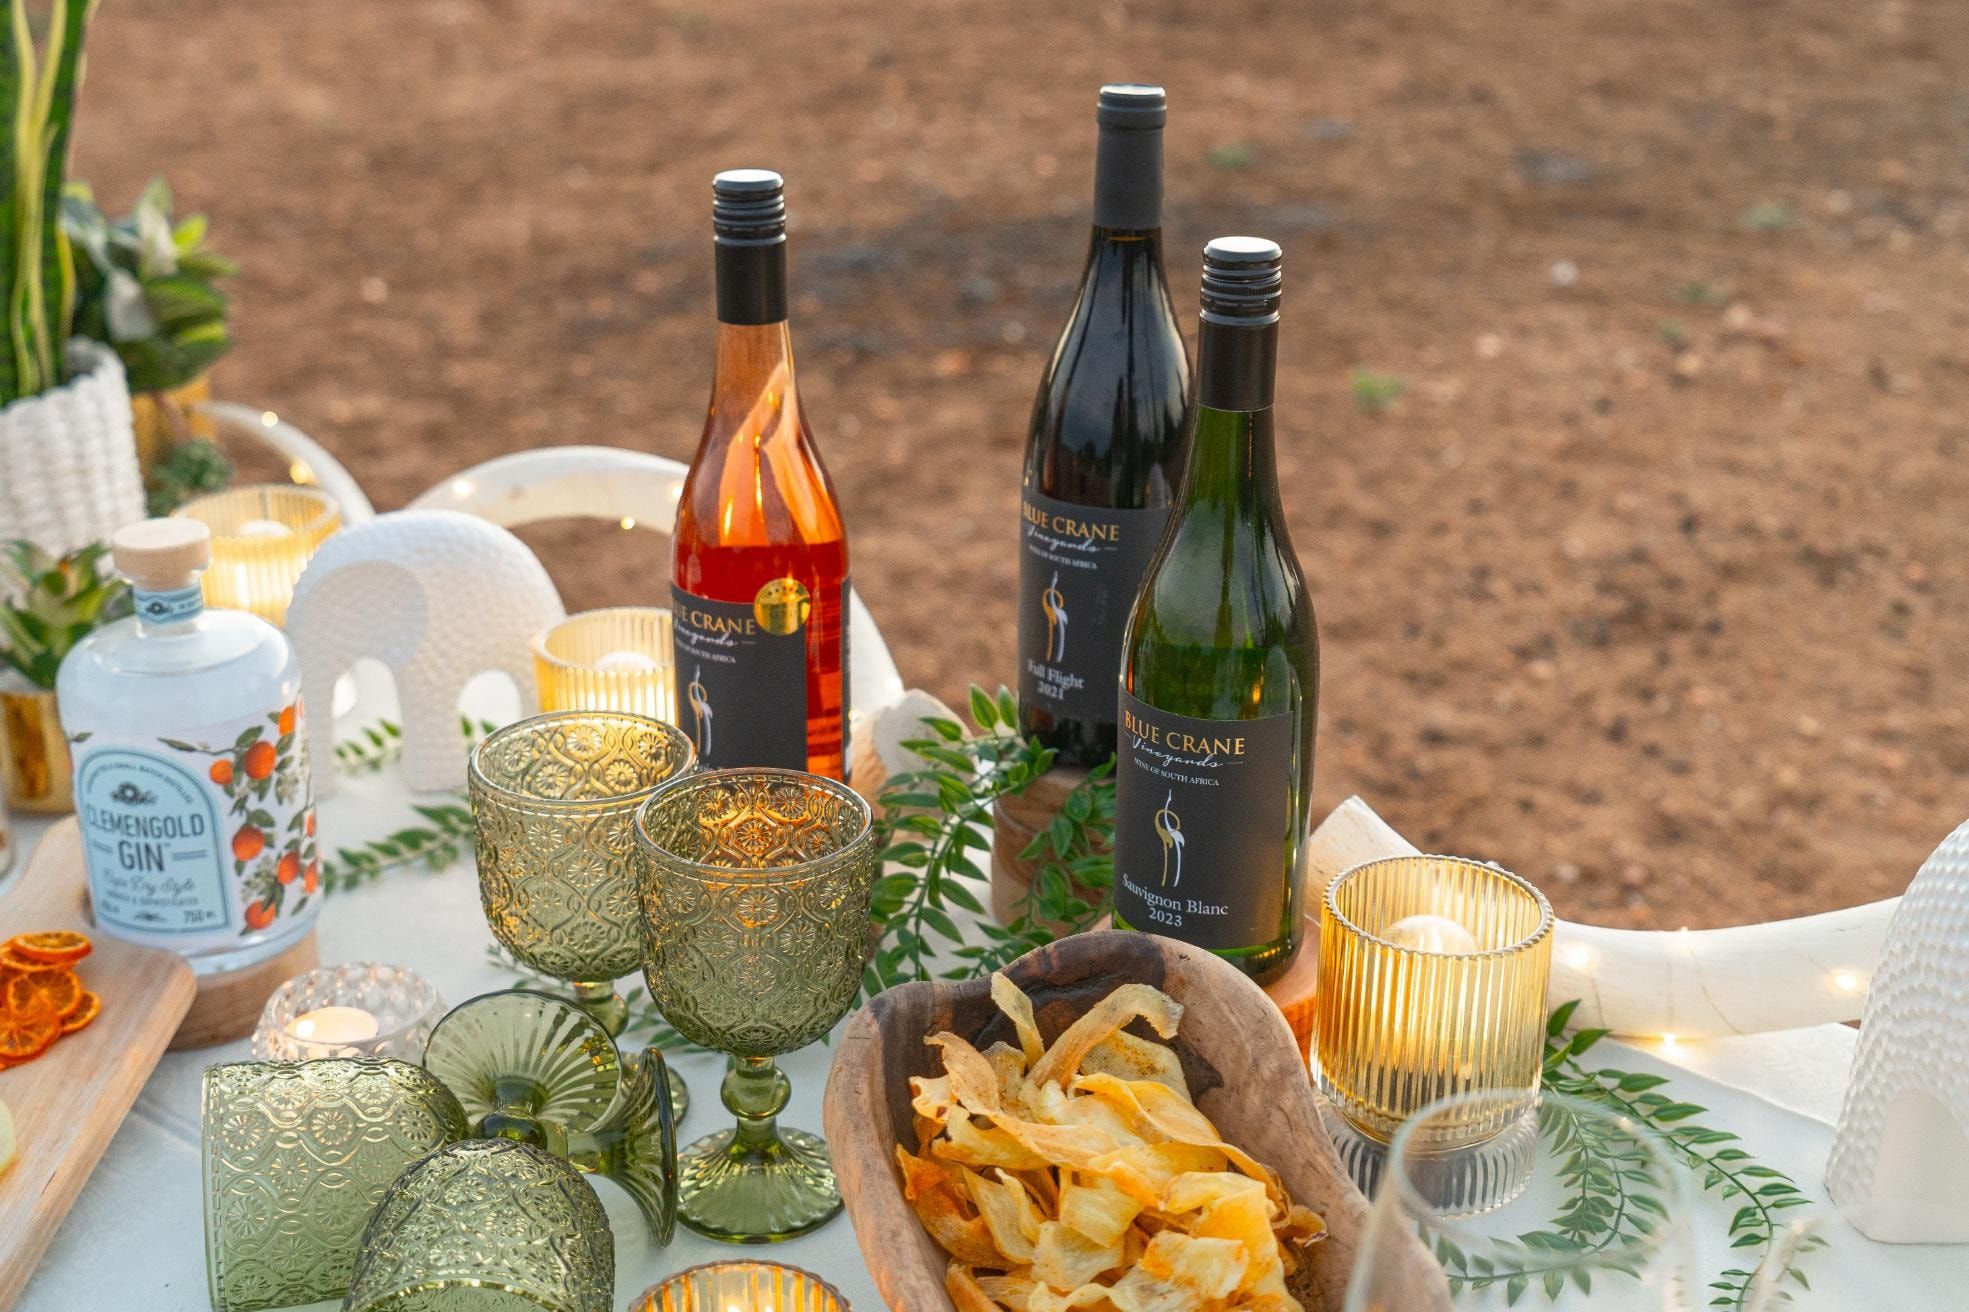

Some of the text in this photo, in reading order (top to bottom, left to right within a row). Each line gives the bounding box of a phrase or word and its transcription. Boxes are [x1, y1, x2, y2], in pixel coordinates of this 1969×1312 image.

[1052, 516, 1120, 541] CRANE
[691, 611, 756, 635] CRANE
[1047, 668, 1085, 690] Flight
[1125, 709, 1245, 755] BLUE CRANE
[1132, 735, 1223, 767] Vineyards
[1150, 766, 1160, 775] OF
[1160, 770, 1188, 783] SOUTH
[1189, 777, 1220, 786] AFRICA
[118, 840, 165, 872] GIN
[1122, 872, 1229, 915] Sauvignon Blanc
[1149, 907, 1183, 927] 2023
